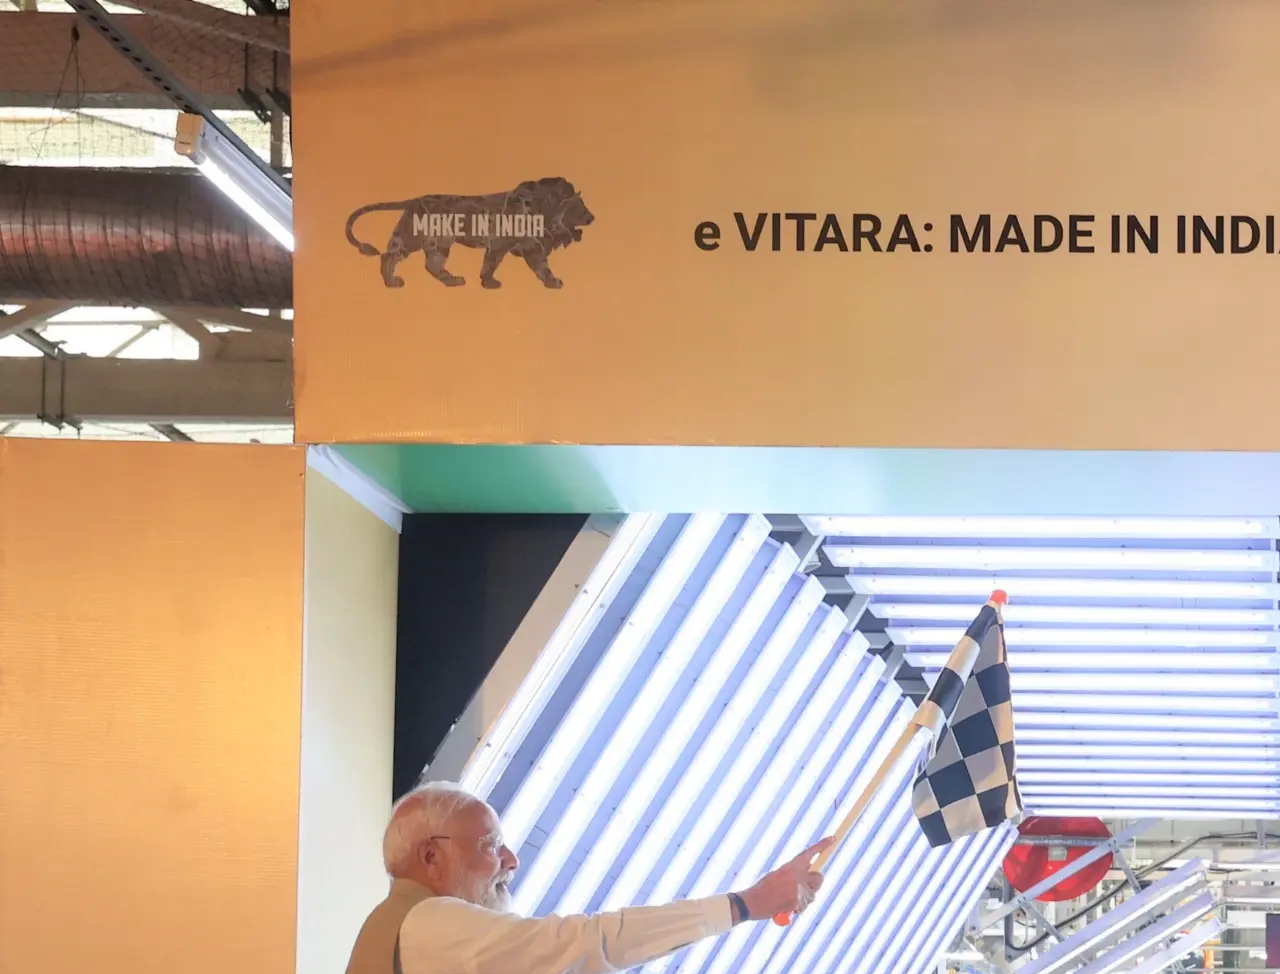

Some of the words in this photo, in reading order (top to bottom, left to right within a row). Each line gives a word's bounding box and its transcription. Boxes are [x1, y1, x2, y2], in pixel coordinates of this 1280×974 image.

[413, 213, 466, 237] MAKE
[471, 213, 489, 237] IN
[495, 213, 545, 237] INDIA
[693, 221, 721, 251] e
[732, 212, 933, 252] VITARA:
[950, 214, 1095, 253] MADE
[1111, 214, 1159, 254] IN
